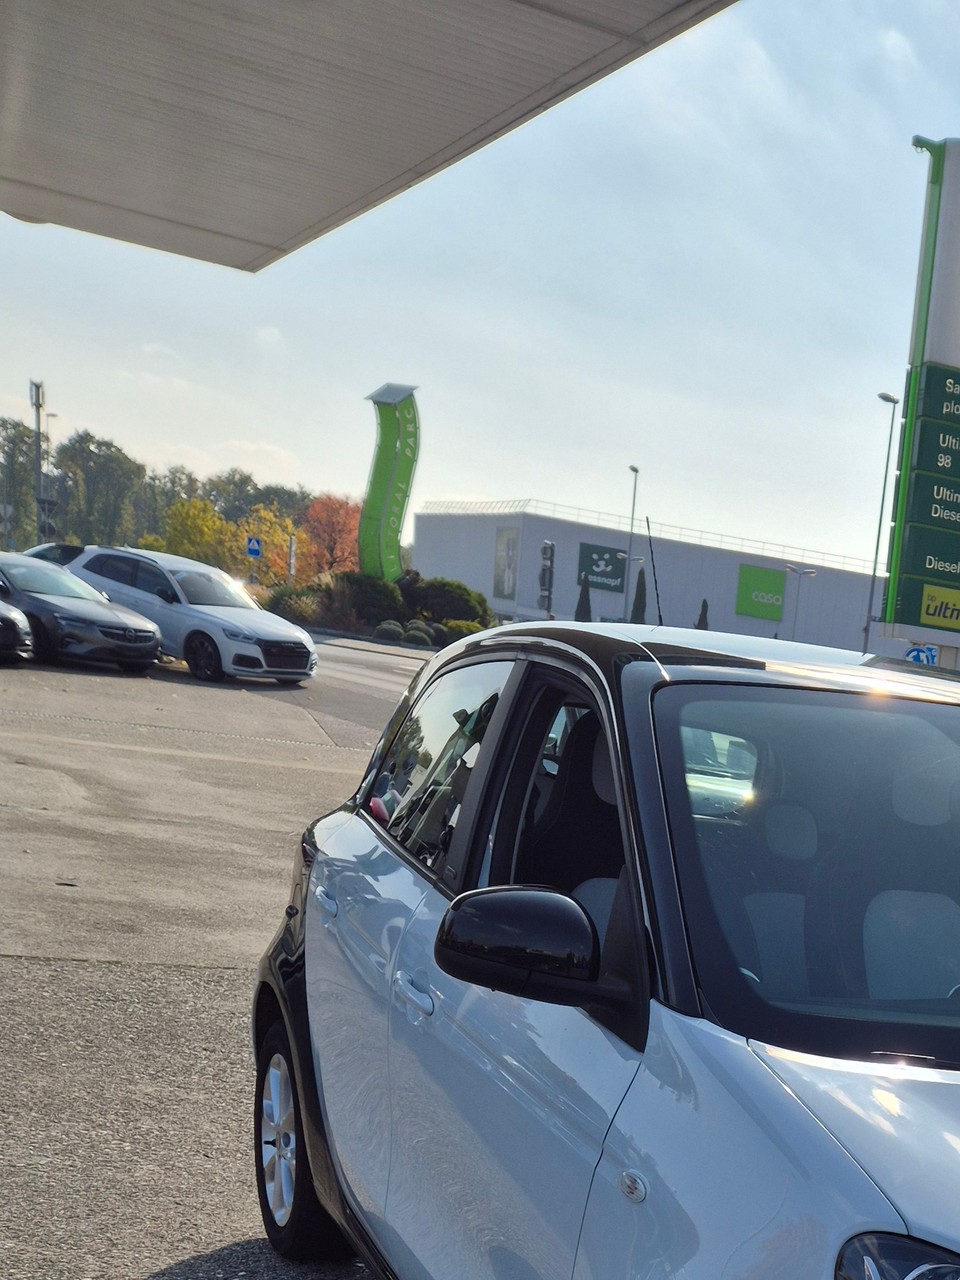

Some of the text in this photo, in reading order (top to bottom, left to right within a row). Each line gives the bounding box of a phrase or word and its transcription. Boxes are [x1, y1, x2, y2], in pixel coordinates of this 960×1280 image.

[405, 407, 416, 458] PARC
[937, 454, 952, 468] 98
[925, 555, 960, 574] Diesel
[581, 571, 621, 587] fessnapf
[752, 591, 782, 605] casa
